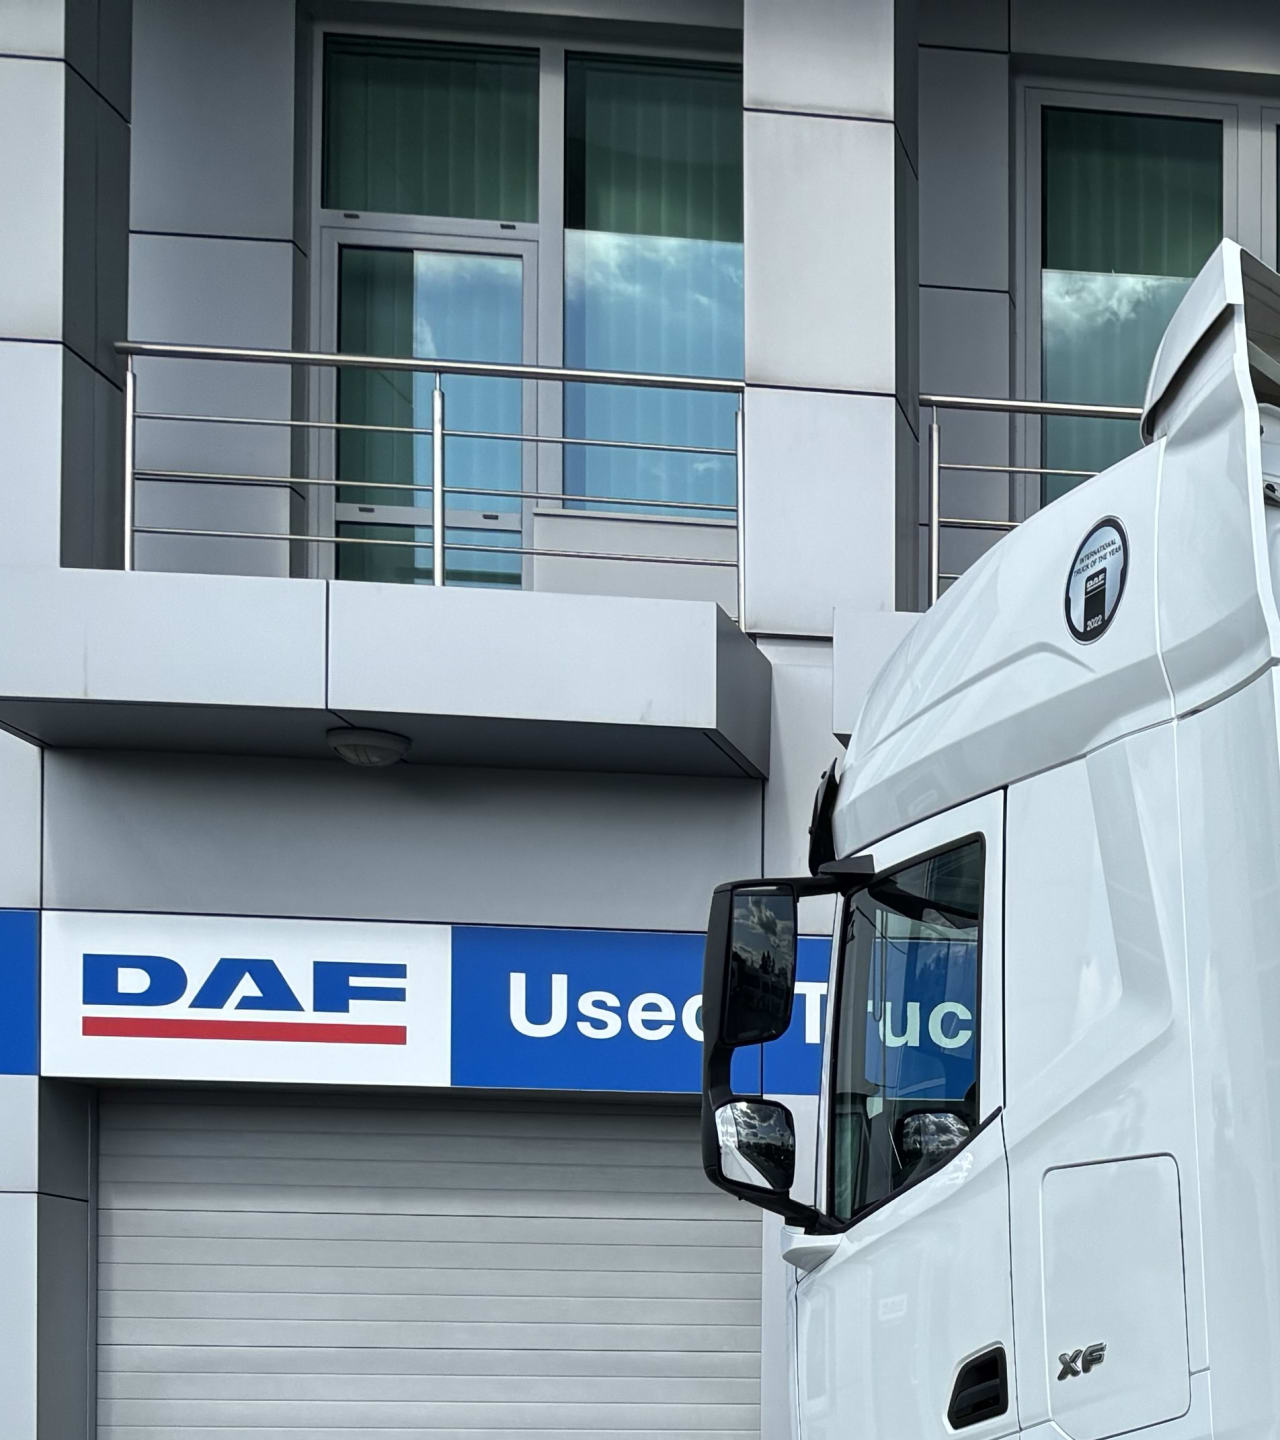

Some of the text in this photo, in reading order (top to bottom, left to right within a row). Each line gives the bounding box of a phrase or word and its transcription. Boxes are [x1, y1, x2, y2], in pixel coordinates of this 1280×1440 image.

[1073, 564, 1089, 577] TRUCK
[1090, 558, 1097, 568] OF
[1109, 545, 1121, 556] YEAR
[1079, 539, 1116, 563] INTERNATIONAL
[1086, 573, 1105, 587] DAF
[1086, 614, 1102, 630] 2022
[82, 953, 407, 1014] DAF
[1058, 1342, 1106, 1381] XF
